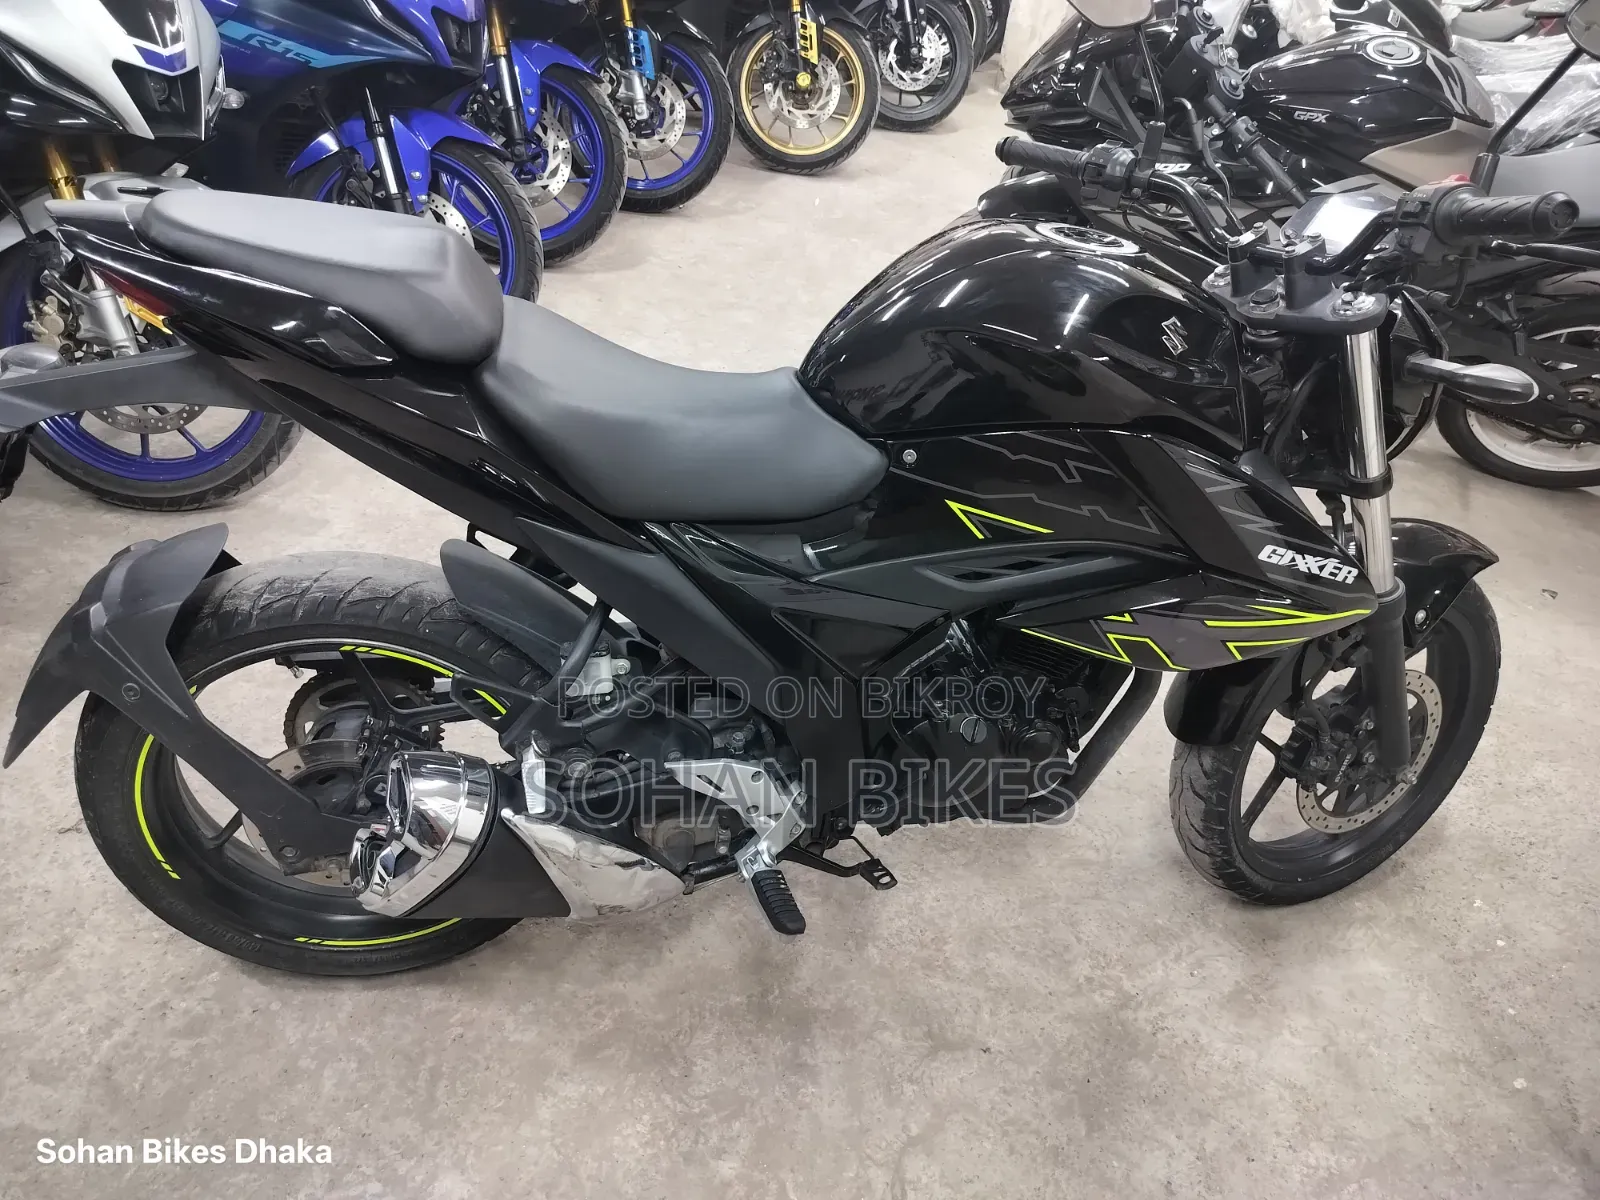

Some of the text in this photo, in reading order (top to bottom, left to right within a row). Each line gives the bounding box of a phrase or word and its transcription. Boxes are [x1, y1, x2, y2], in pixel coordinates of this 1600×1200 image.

[241, 33, 319, 66] R15
[1293, 110, 1330, 123] GPX
[1257, 544, 1359, 585] GIXXER
